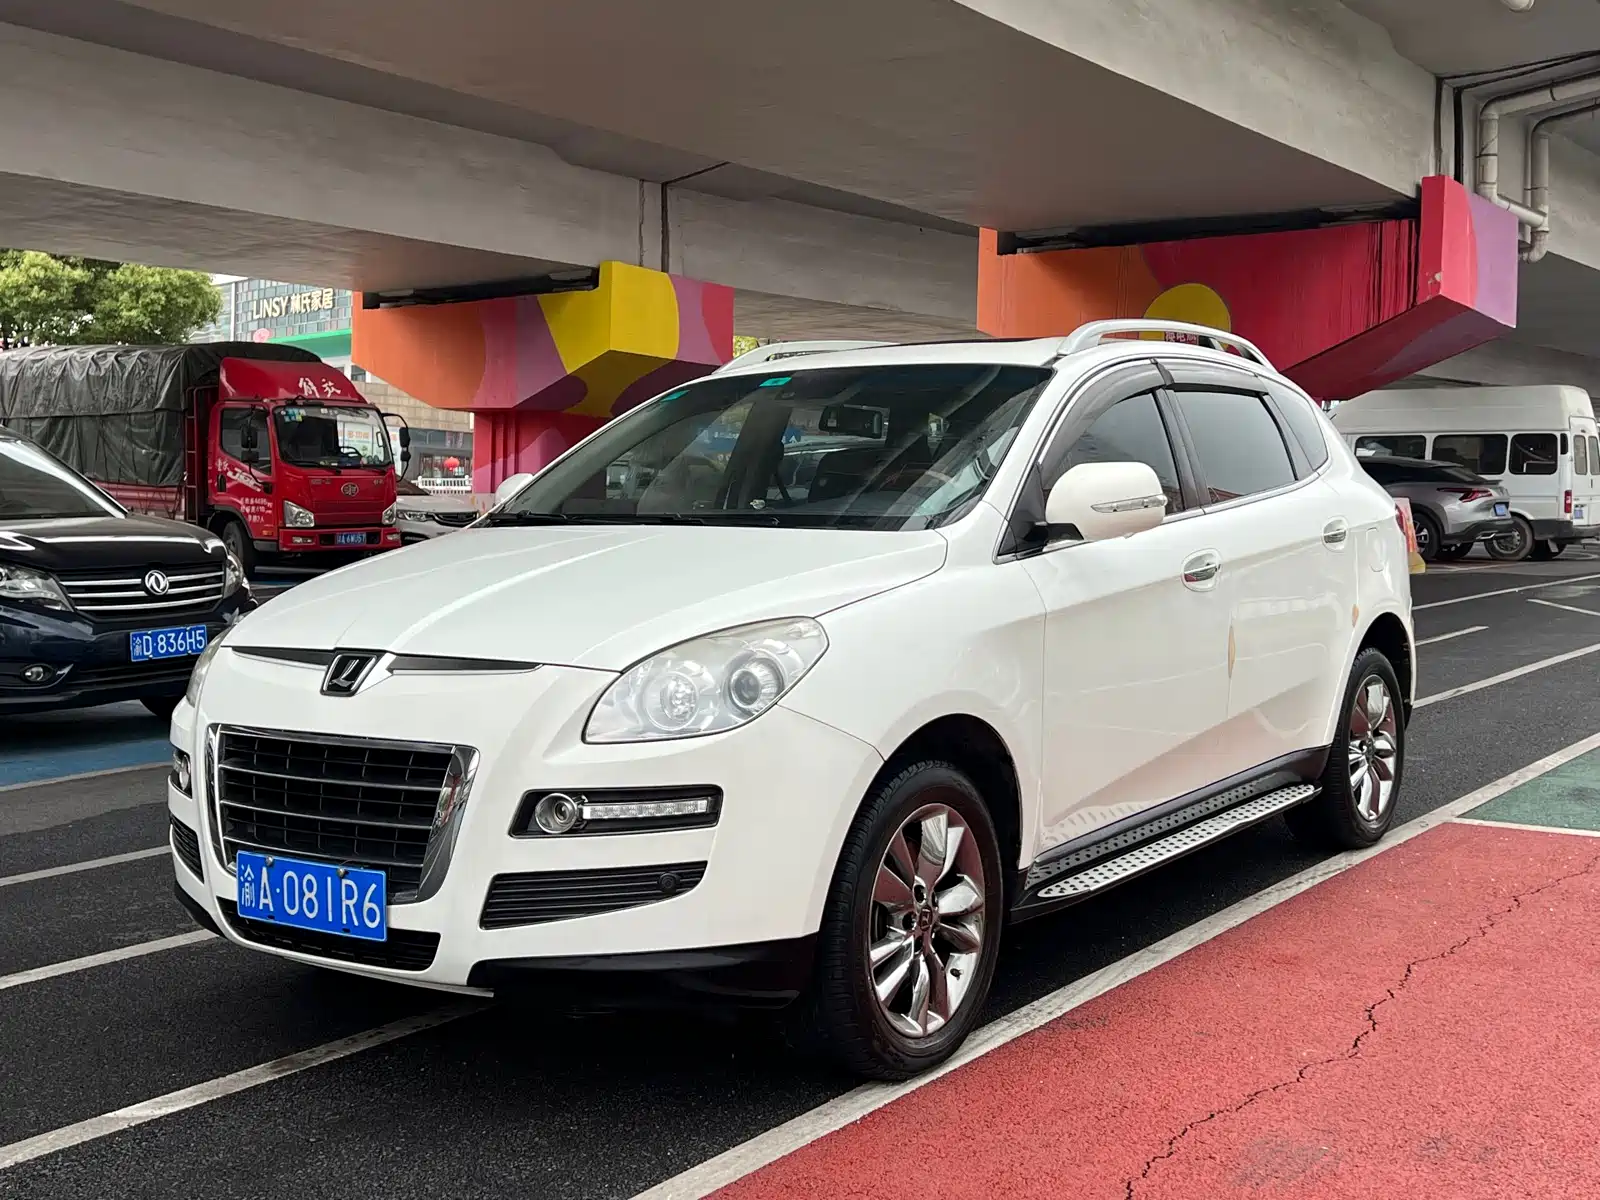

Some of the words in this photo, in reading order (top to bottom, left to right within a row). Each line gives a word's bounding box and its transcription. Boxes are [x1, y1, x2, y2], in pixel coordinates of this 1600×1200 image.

[252, 295, 288, 320] LINSY
[290, 287, 335, 314] 林氏家居
